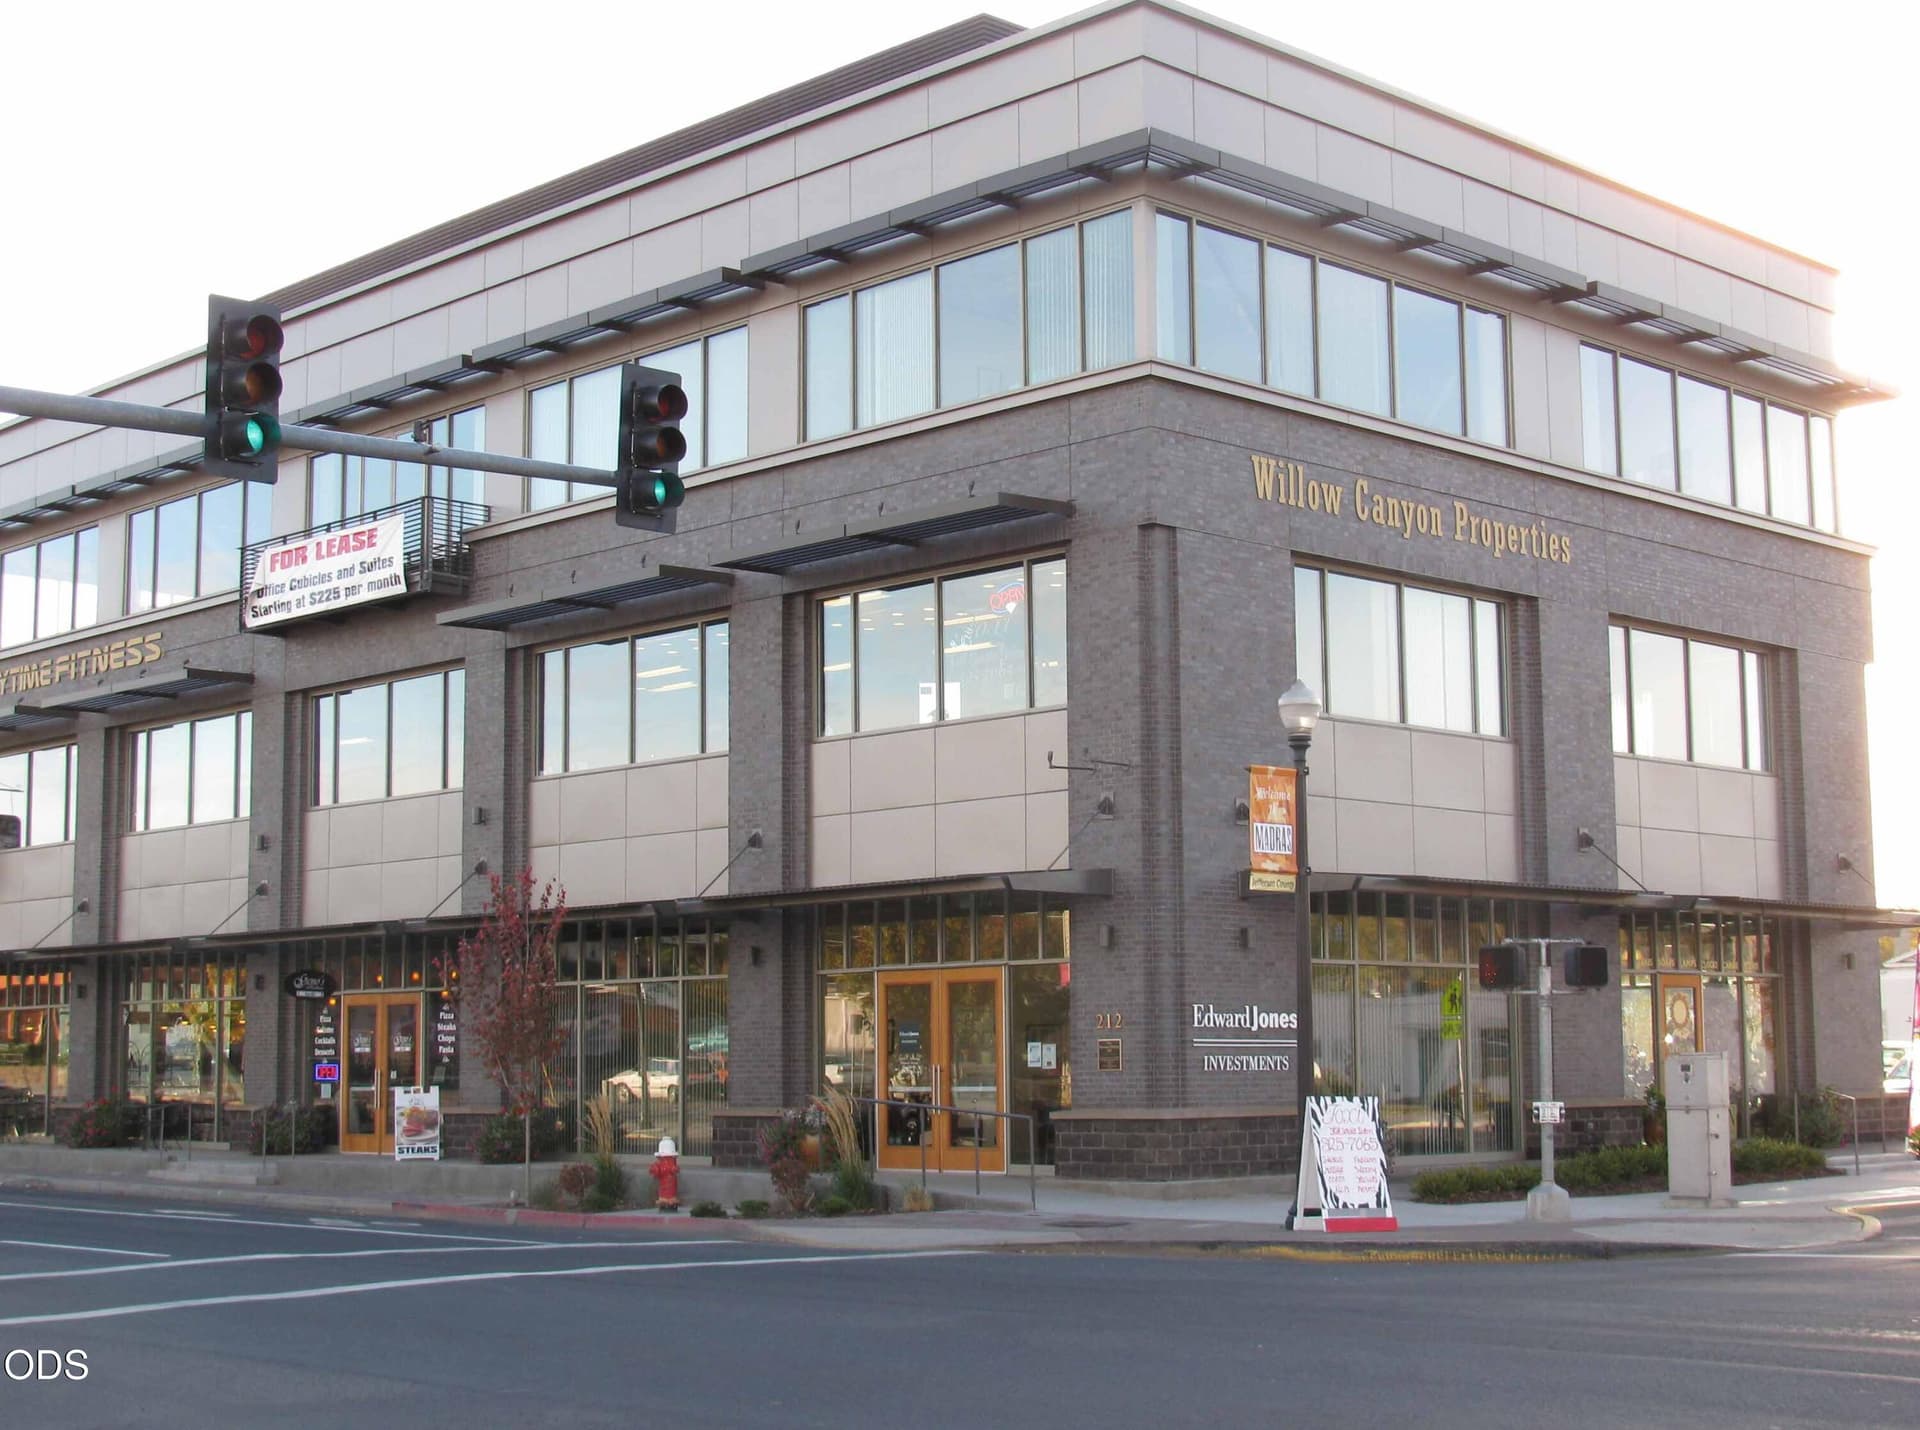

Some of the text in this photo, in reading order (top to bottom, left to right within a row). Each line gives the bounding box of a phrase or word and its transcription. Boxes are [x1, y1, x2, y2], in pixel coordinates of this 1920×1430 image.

[1251, 455, 1571, 565] Willow Canyon Properties
[269, 528, 379, 573] FOR LEASE
[289, 571, 333, 592] Cubicles
[337, 564, 356, 580] and
[359, 556, 395, 574] Suites
[251, 598, 292, 619] Starting
[295, 594, 306, 609] at
[344, 582, 363, 600] per
[367, 572, 402, 592] month
[54, 632, 163, 682] FITNESS
[1255, 825, 1292, 852] MADRAS
[1096, 1013, 1121, 1029] 212
[1204, 1055, 1289, 1071] INVESTMENTS
[397, 1145, 438, 1155] STEAKS
